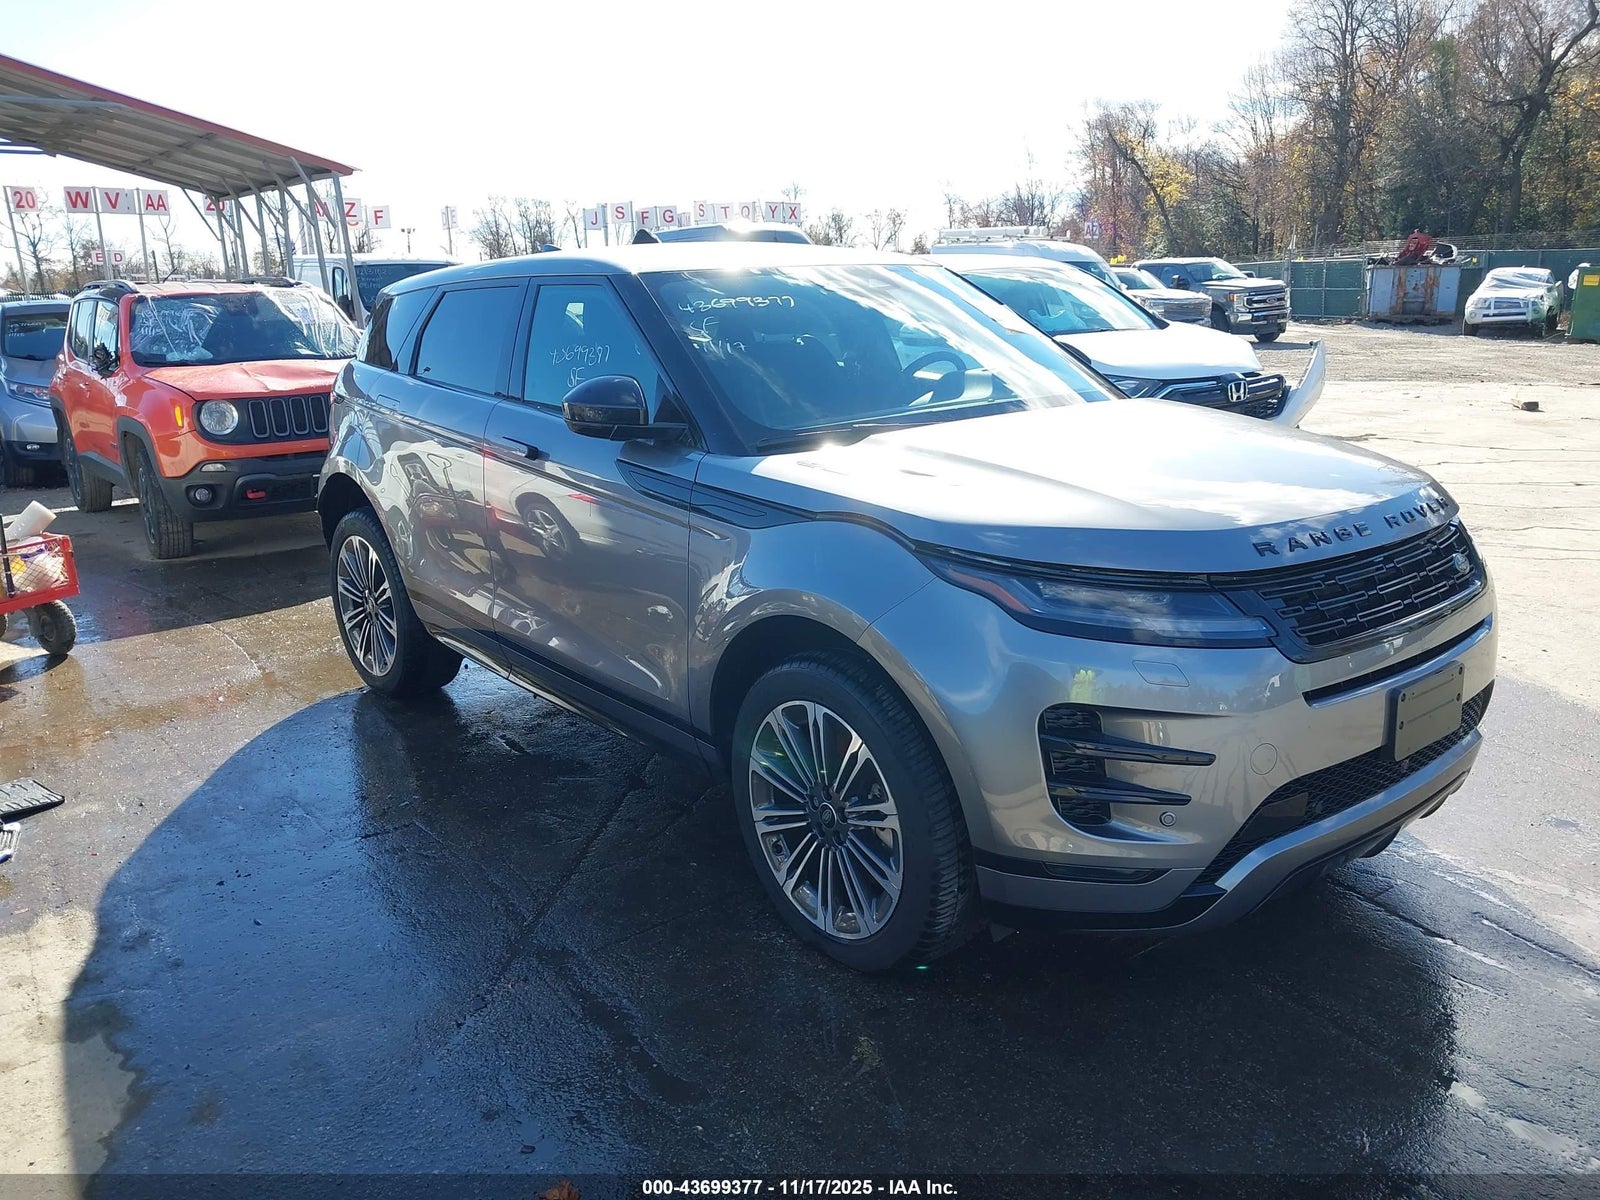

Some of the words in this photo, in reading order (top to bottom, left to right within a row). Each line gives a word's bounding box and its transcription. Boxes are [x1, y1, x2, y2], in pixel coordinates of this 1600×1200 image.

[13, 190, 36, 209] 20
[66, 191, 90, 209] W
[104, 191, 120, 209] V
[145, 193, 168, 212] AA
[344, 202, 358, 218] Z
[373, 209, 384, 225] F
[615, 206, 625, 220] S
[641, 210, 650, 225] F
[662, 209, 675, 223] G
[698, 203, 706, 218] S
[720, 206, 730, 220] T
[740, 205, 751, 220] Q
[768, 205, 778, 219] Y
[788, 206, 798, 220] X
[591, 211, 598, 225] J
[95, 252, 104, 263] E
[113, 252, 123, 263] D
[678, 295, 795, 314] 43699377
[1251, 520, 1372, 558] RANGE
[1383, 495, 1450, 530] ROVER
